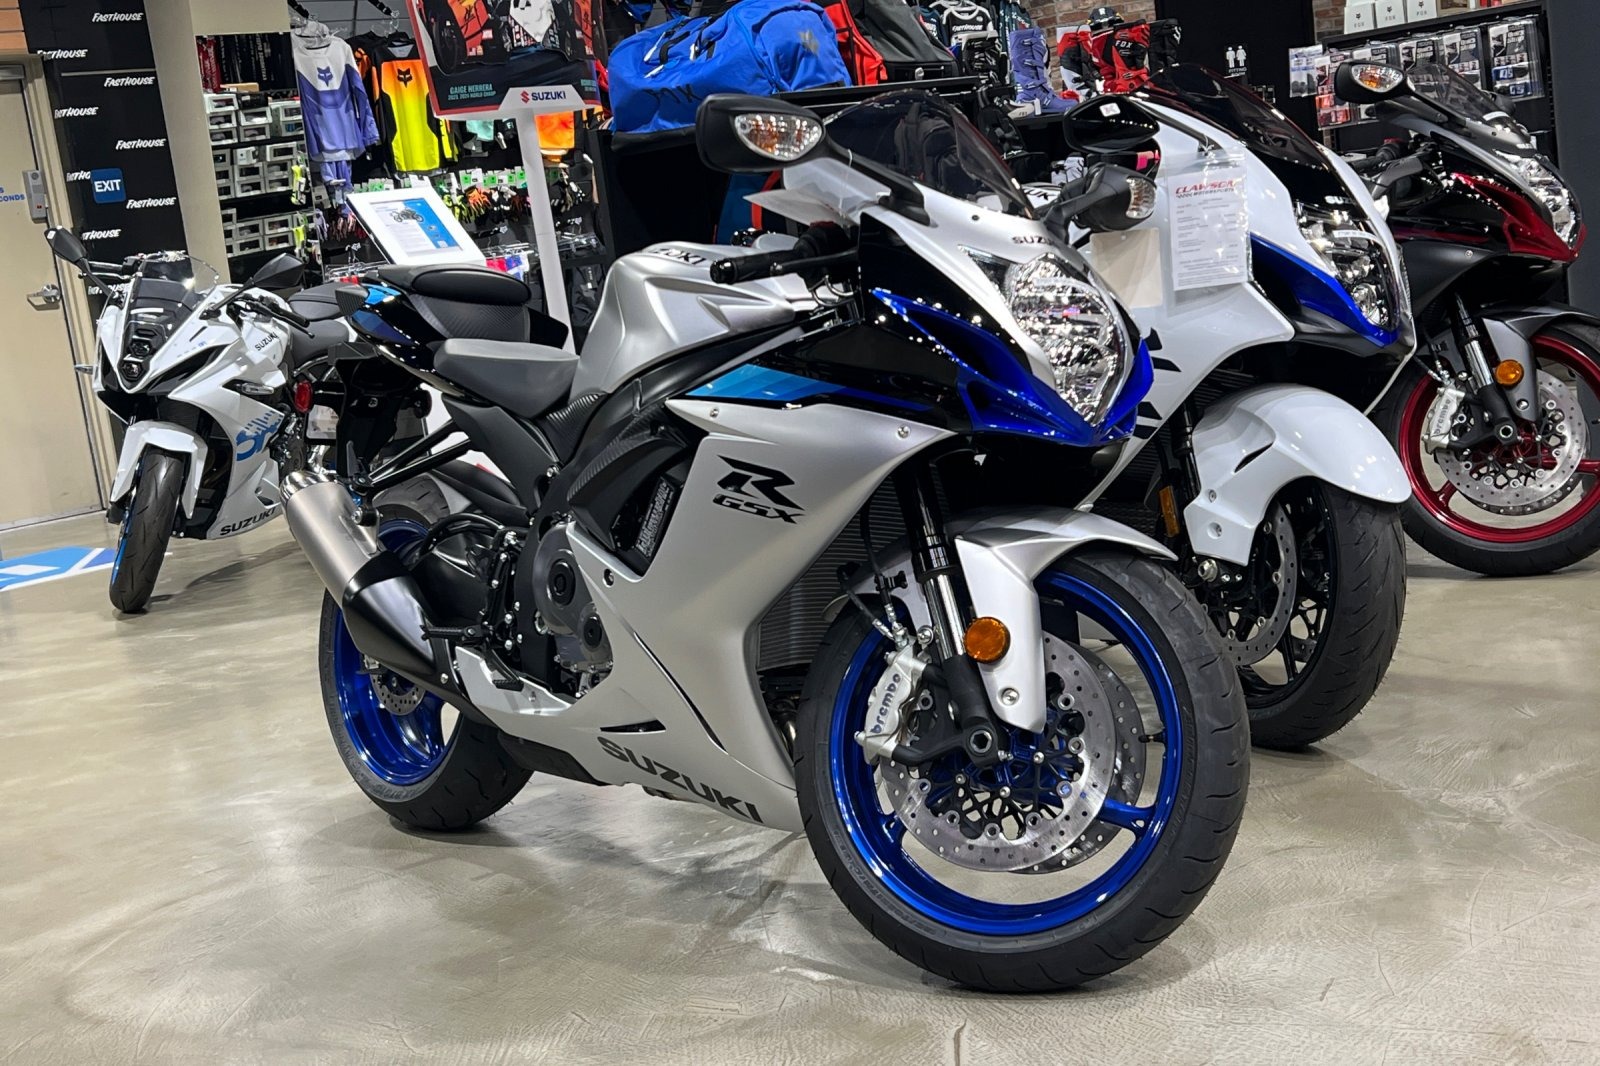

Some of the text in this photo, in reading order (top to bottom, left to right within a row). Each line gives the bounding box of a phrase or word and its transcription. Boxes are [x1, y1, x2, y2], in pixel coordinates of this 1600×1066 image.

[92, 12, 144, 22] FASTHOUSE
[1115, 40, 1133, 48] FOX
[104, 76, 155, 87] FASTHOUSE
[468, 83, 492, 93] HERRERA
[531, 90, 567, 101] SUZUKI
[115, 139, 167, 150] FASTHOUSE
[94, 179, 121, 192] EXIT
[126, 197, 177, 209] FASTHOUSE
[1433, 398, 1451, 435] brembo
[713, 494, 806, 524] GSX
[219, 506, 277, 536] SUZUKI
[870, 673, 902, 734] brembo
[597, 736, 764, 824] SUZUKI
